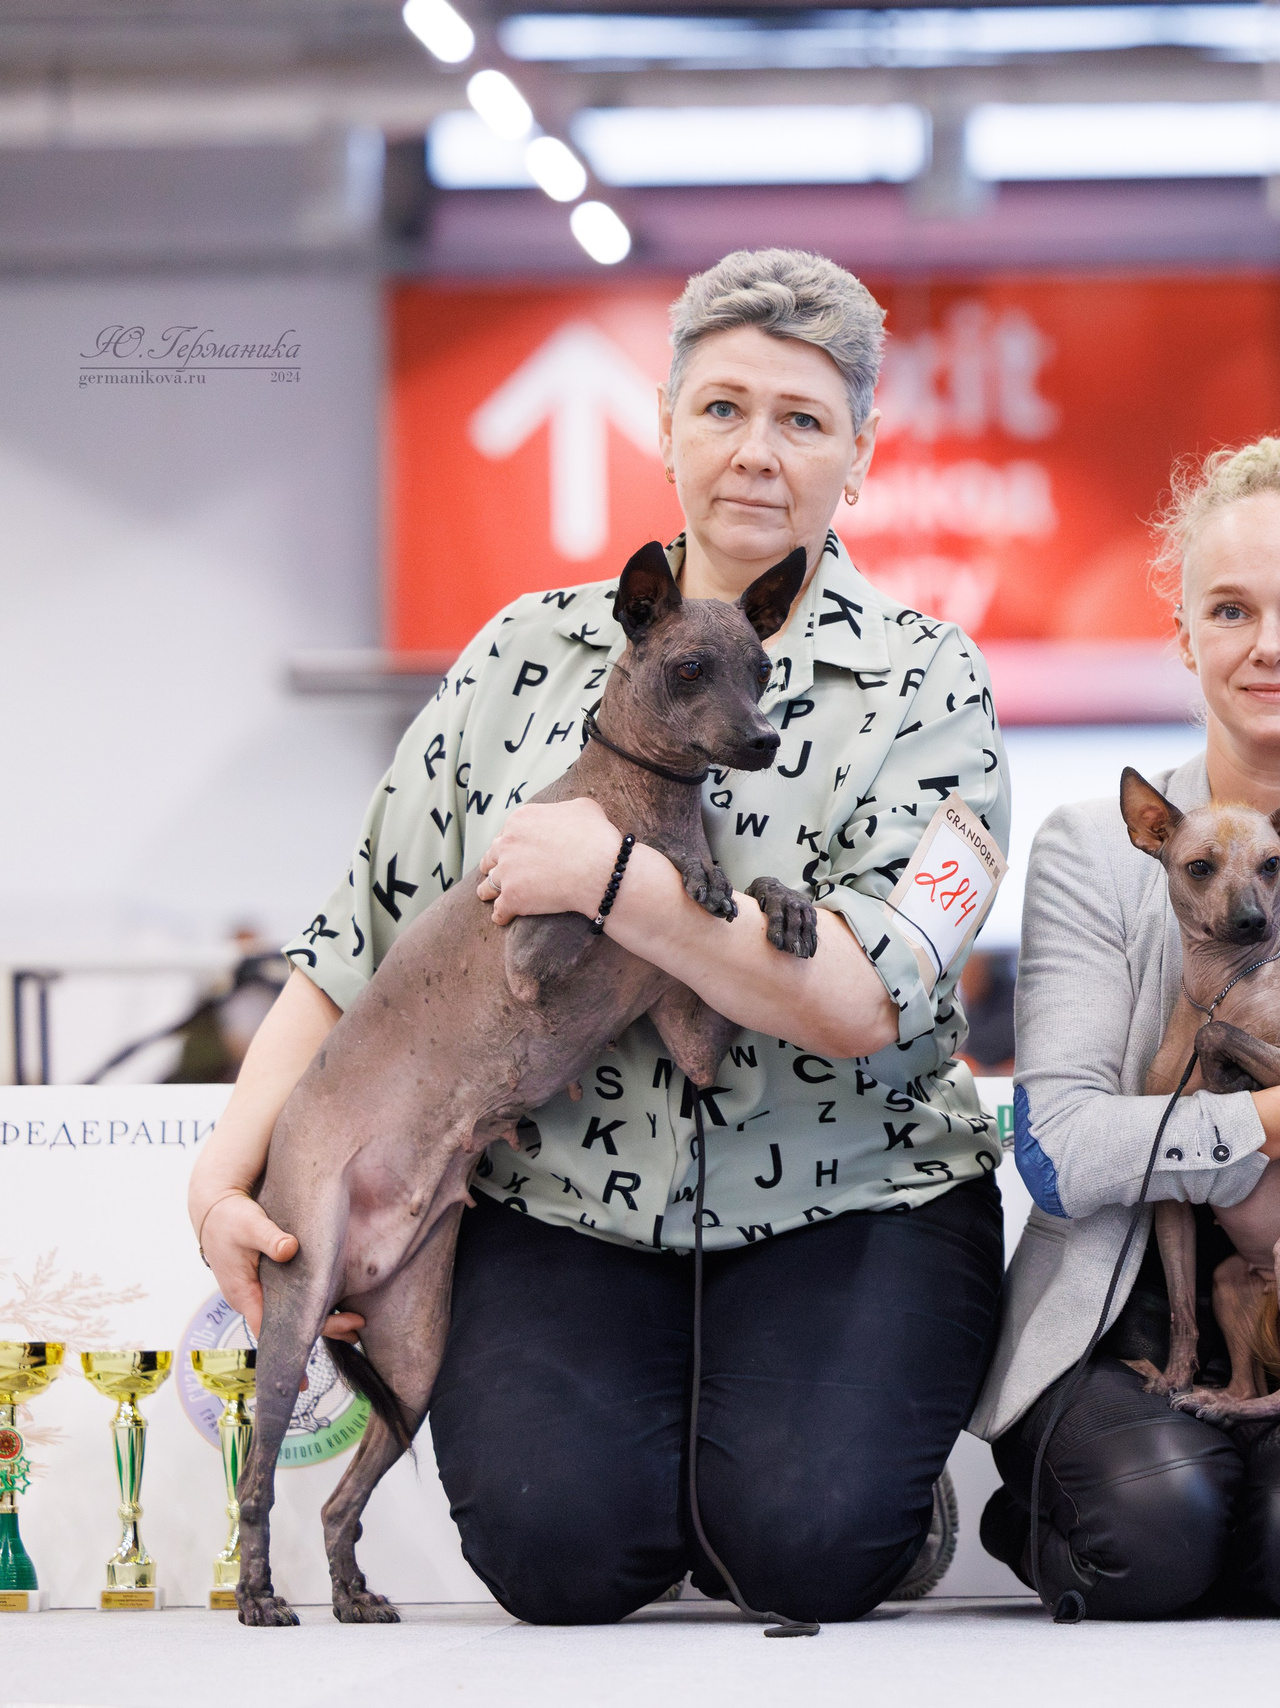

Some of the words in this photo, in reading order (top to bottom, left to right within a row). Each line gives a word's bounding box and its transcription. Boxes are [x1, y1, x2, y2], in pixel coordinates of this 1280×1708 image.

[818, 587, 864, 640] K
[512, 660, 549, 697] P
[780, 699, 815, 729] P
[859, 711, 877, 734] Z
[504, 712, 536, 754] J
[545, 720, 576, 746] H
[777, 740, 812, 778] J
[505, 781, 529, 810] K
[709, 789, 734, 810] Q
[735, 812, 770, 838] W
[796, 824, 823, 854] K
[946, 808, 996, 868] GRANDORF
[372, 852, 419, 923] K
[914, 860, 978, 928] 284
[728, 1045, 758, 1069] W
[792, 1054, 837, 1084] C
[594, 1065, 624, 1101] S
[817, 1100, 837, 1124] Z
[0, 1119, 216, 1150] ФЕДЕРАЦИ
[581, 1116, 627, 1156] K
[882, 1121, 921, 1152] K
[754, 1143, 783, 1189] J
[815, 1158, 839, 1188] H
[602, 1169, 642, 1212] R
